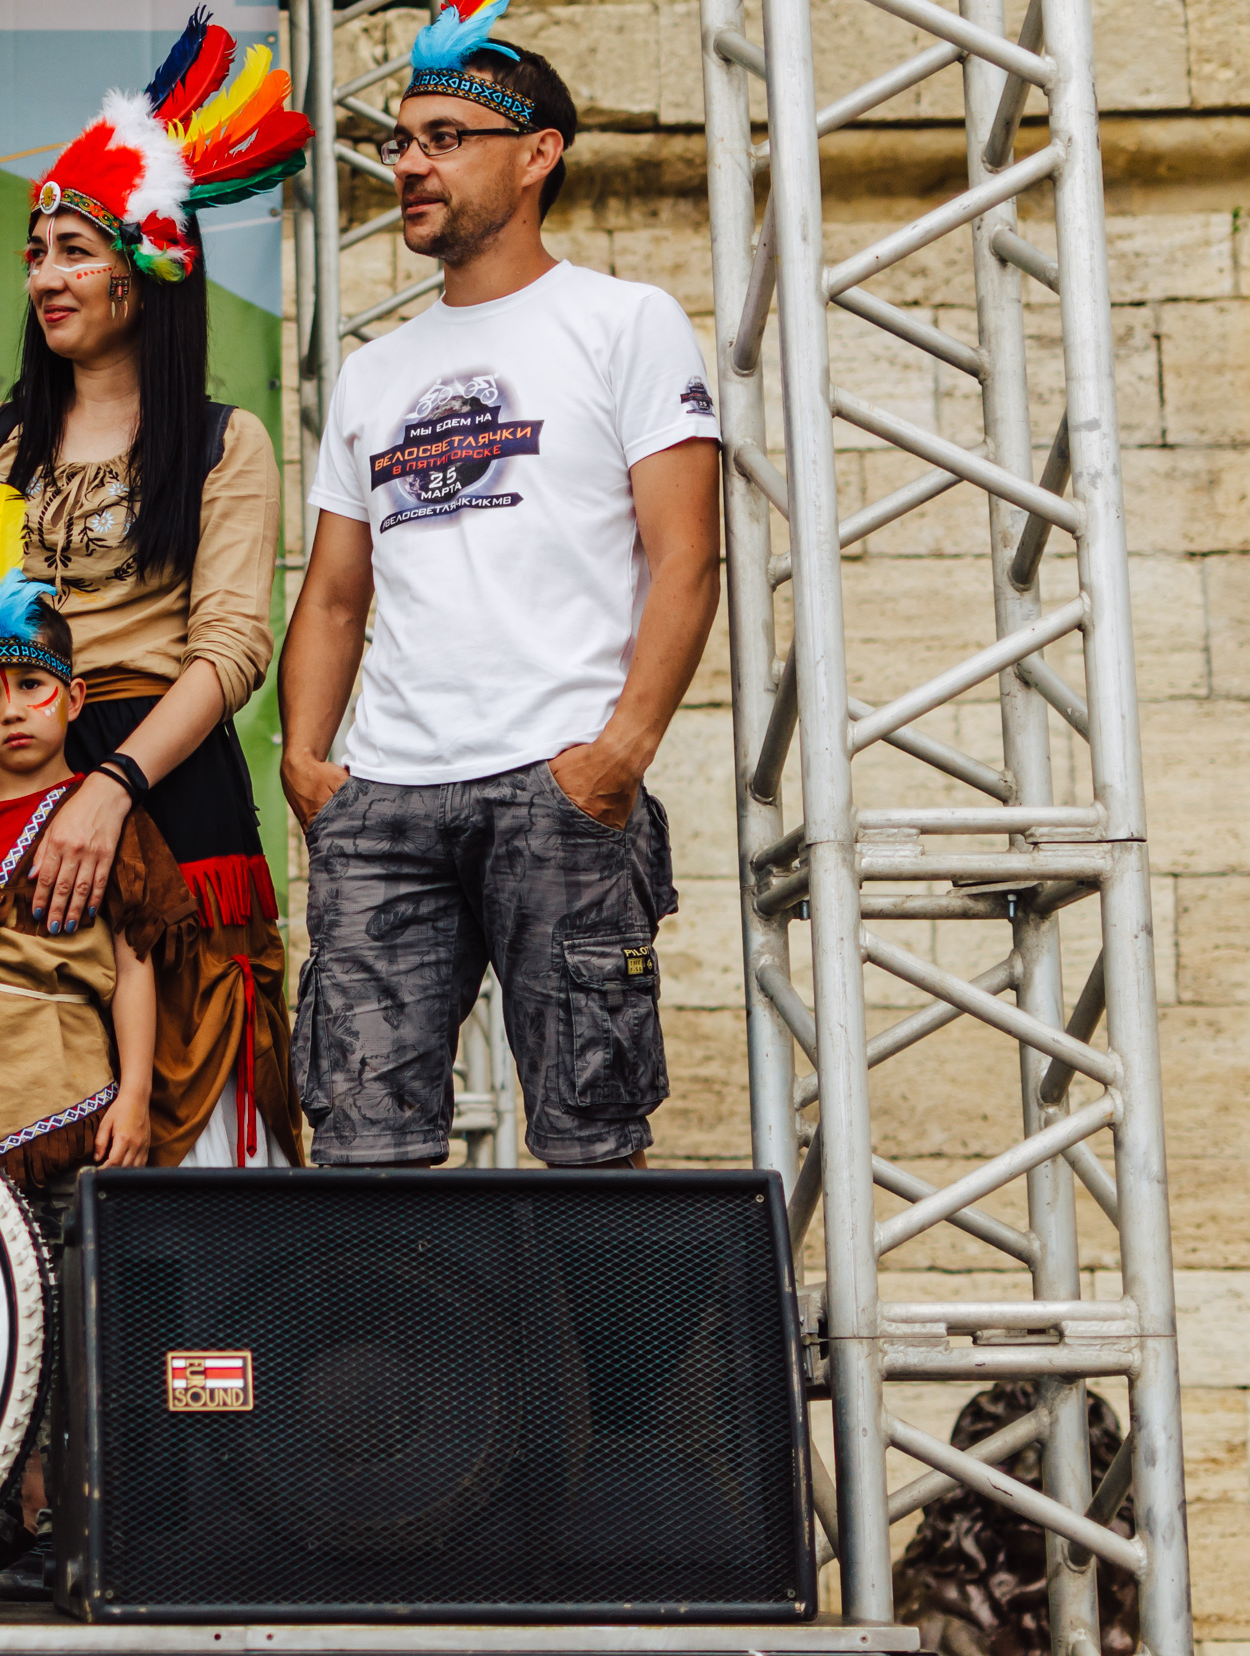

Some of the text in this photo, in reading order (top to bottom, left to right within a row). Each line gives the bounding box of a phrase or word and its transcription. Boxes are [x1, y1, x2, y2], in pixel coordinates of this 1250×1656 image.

[410, 412, 492, 438] МЫ ЕДЕМ НА
[374, 426, 532, 472] ВЕЛОСВЕТЛЯЧКИ
[392, 444, 502, 475] В ПЯТИГОРСКЕ
[428, 466, 458, 489] 25
[420, 481, 463, 500] МАРТА
[173, 1387, 244, 1407] SOUND
